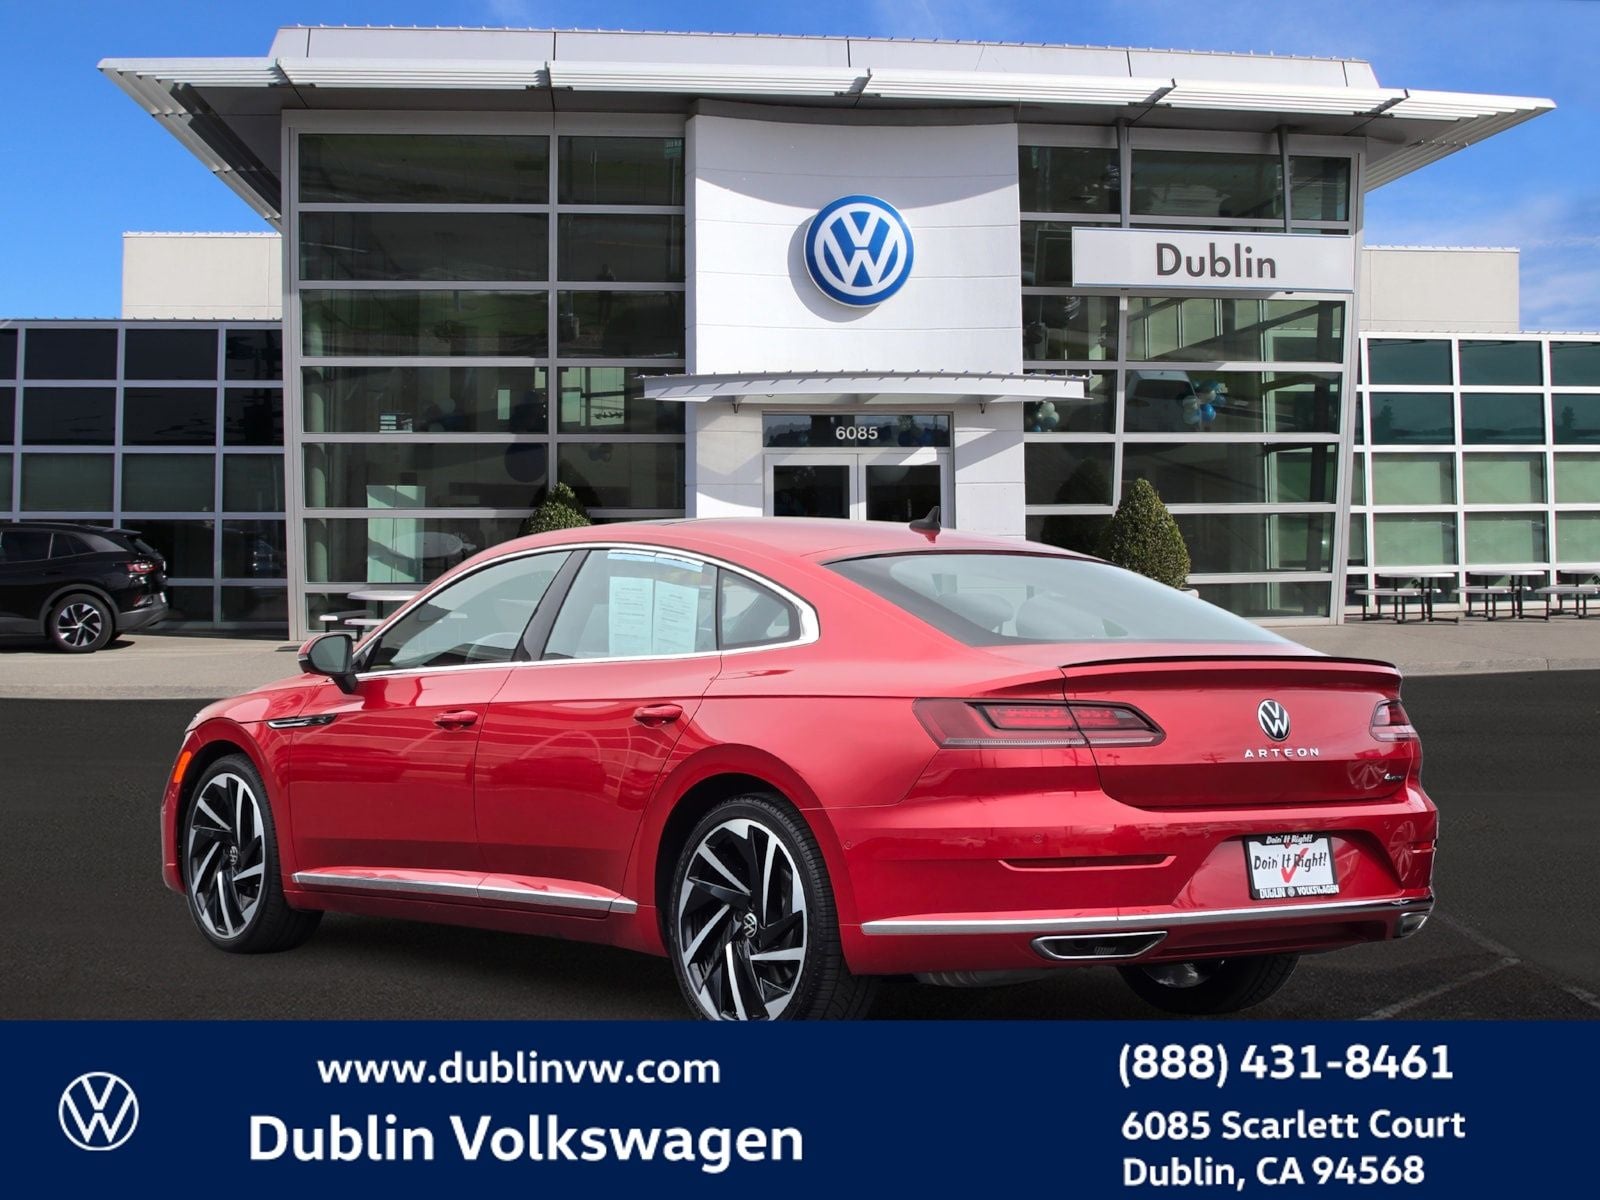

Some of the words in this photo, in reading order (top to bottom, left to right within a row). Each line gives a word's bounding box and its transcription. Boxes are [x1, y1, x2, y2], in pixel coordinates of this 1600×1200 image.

[811, 201, 910, 299] VW
[1156, 242, 1277, 279] Dublin
[835, 425, 879, 441] 6085
[1258, 699, 1290, 741] VW
[1244, 747, 1319, 759] ARTEON
[1253, 854, 1280, 871] Doin'
[1281, 853, 1292, 868] It
[1293, 852, 1328, 873] Right!
[1296, 884, 1340, 896] VOLKSWAGEN
